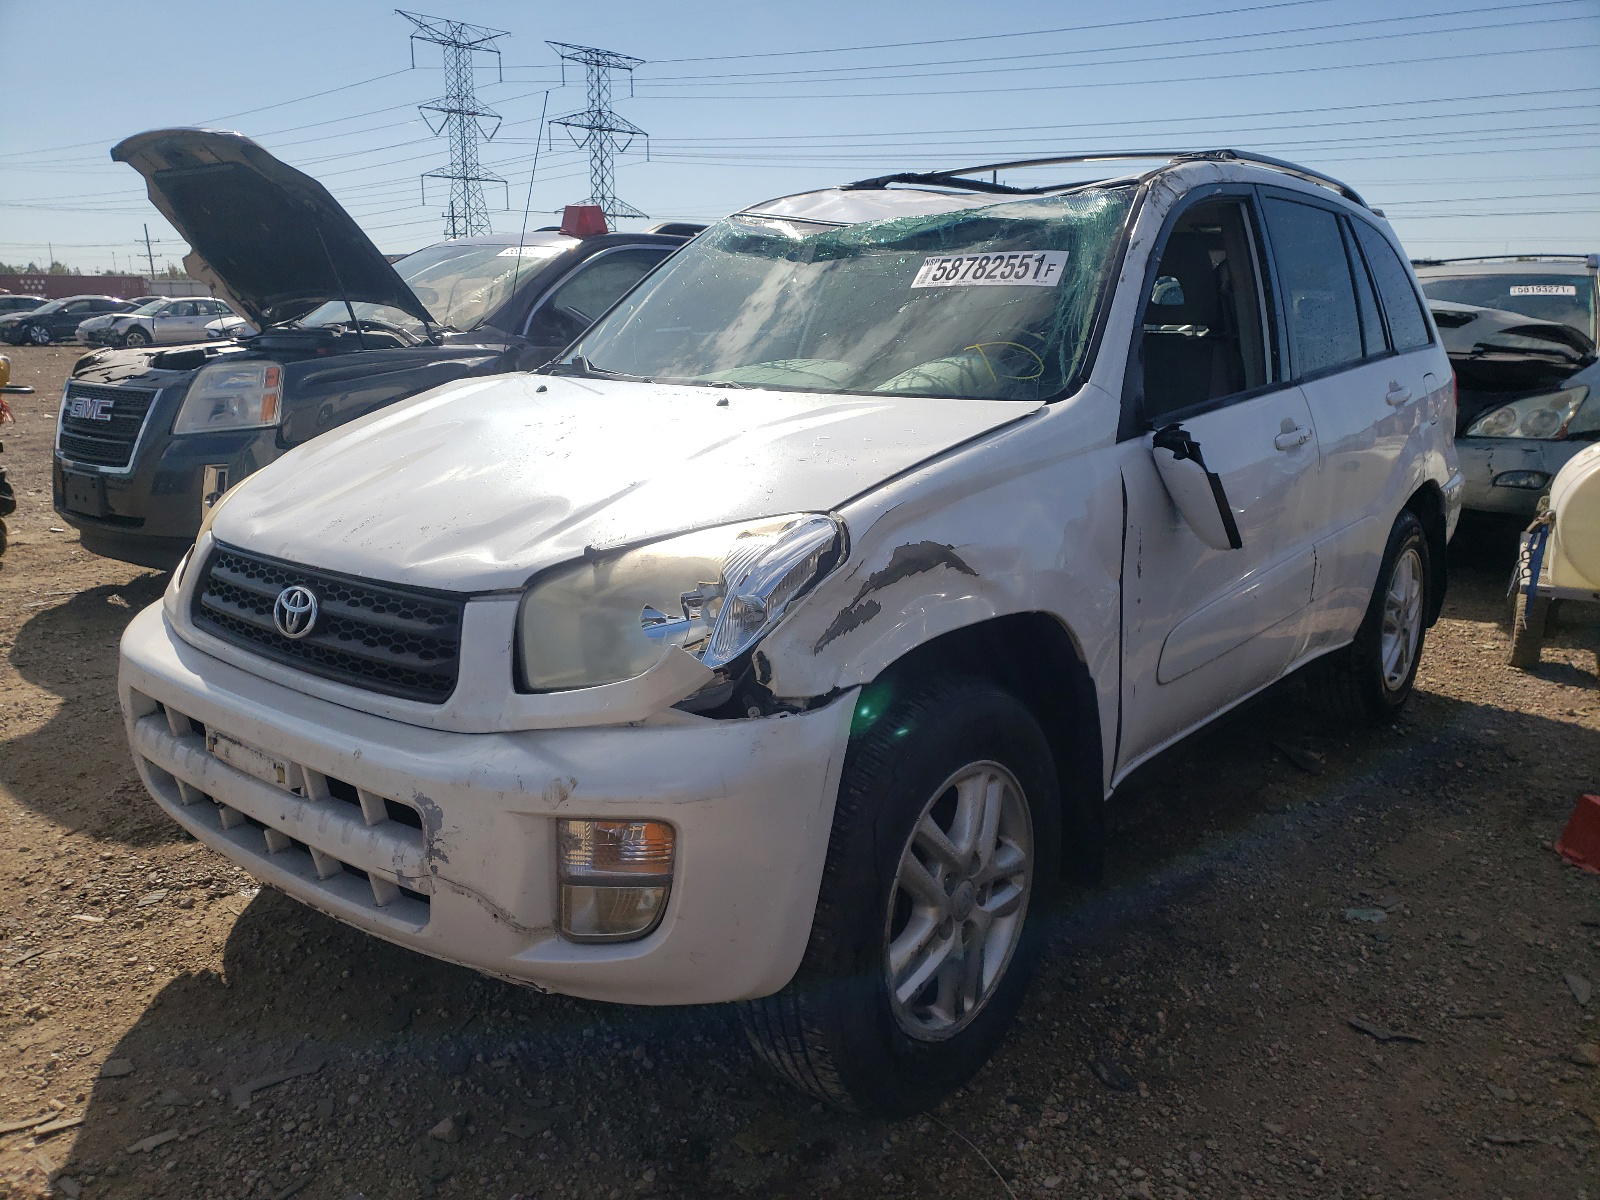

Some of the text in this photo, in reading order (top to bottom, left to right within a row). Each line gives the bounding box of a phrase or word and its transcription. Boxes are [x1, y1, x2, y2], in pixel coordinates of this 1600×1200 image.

[931, 253, 1047, 282] 58782551
[1043, 263, 1057, 278] F
[70, 397, 115, 422] GMC
